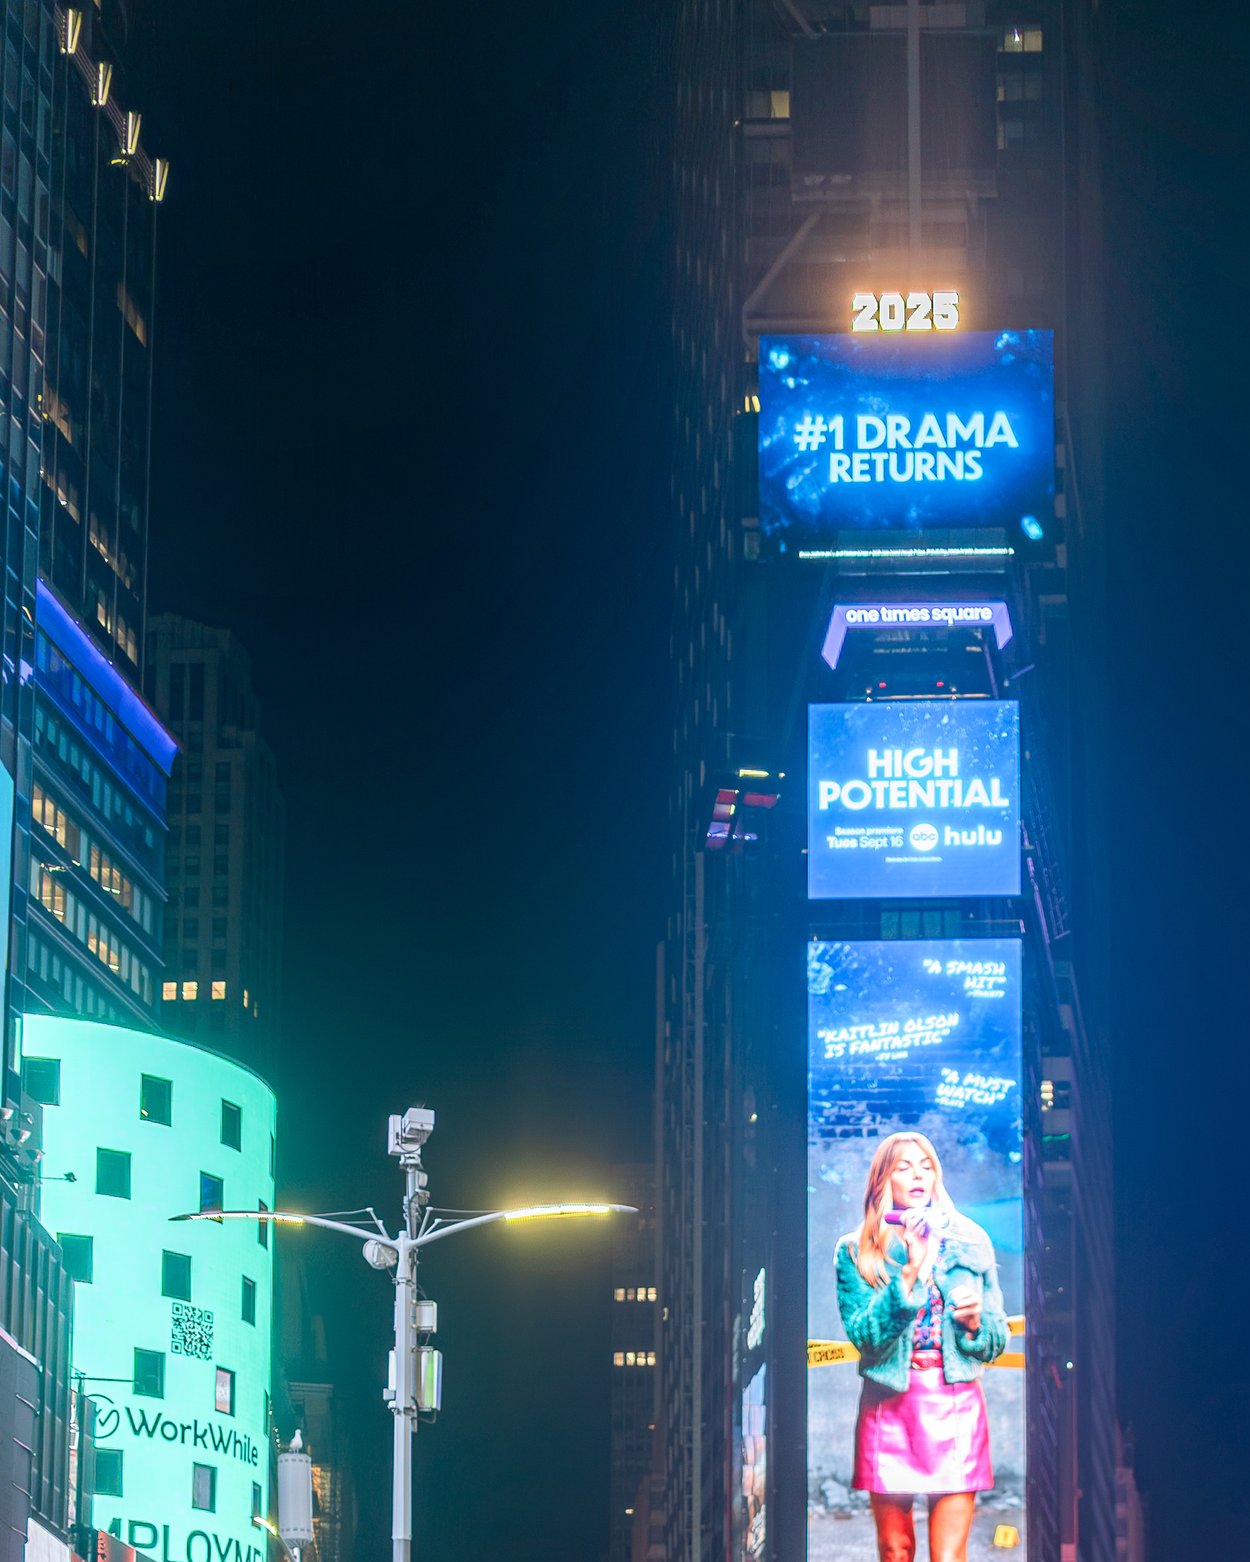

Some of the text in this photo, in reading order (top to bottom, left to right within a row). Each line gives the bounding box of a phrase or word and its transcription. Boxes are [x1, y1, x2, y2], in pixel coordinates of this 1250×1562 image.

[852, 291, 960, 332] 2025
[794, 411, 1019, 450] #1 DRAMA
[829, 450, 983, 483] RETURNS
[846, 606, 993, 626] one times square
[867, 748, 959, 778] HIGH
[818, 779, 1010, 810] POTENTIAL
[827, 835, 904, 850] Tues Sept 16
[912, 831, 936, 841] abc
[944, 825, 1003, 846] hulu
[946, 960, 1005, 976] SMASH
[818, 1011, 960, 1044] "KAITLIN OLSON
[824, 1028, 951, 1059] IS FANTASTIC"
[936, 1082, 1006, 1105] WATCH"
[963, 1073, 1017, 1093] MUST
[125, 1406, 259, 1467] WorkWhile
